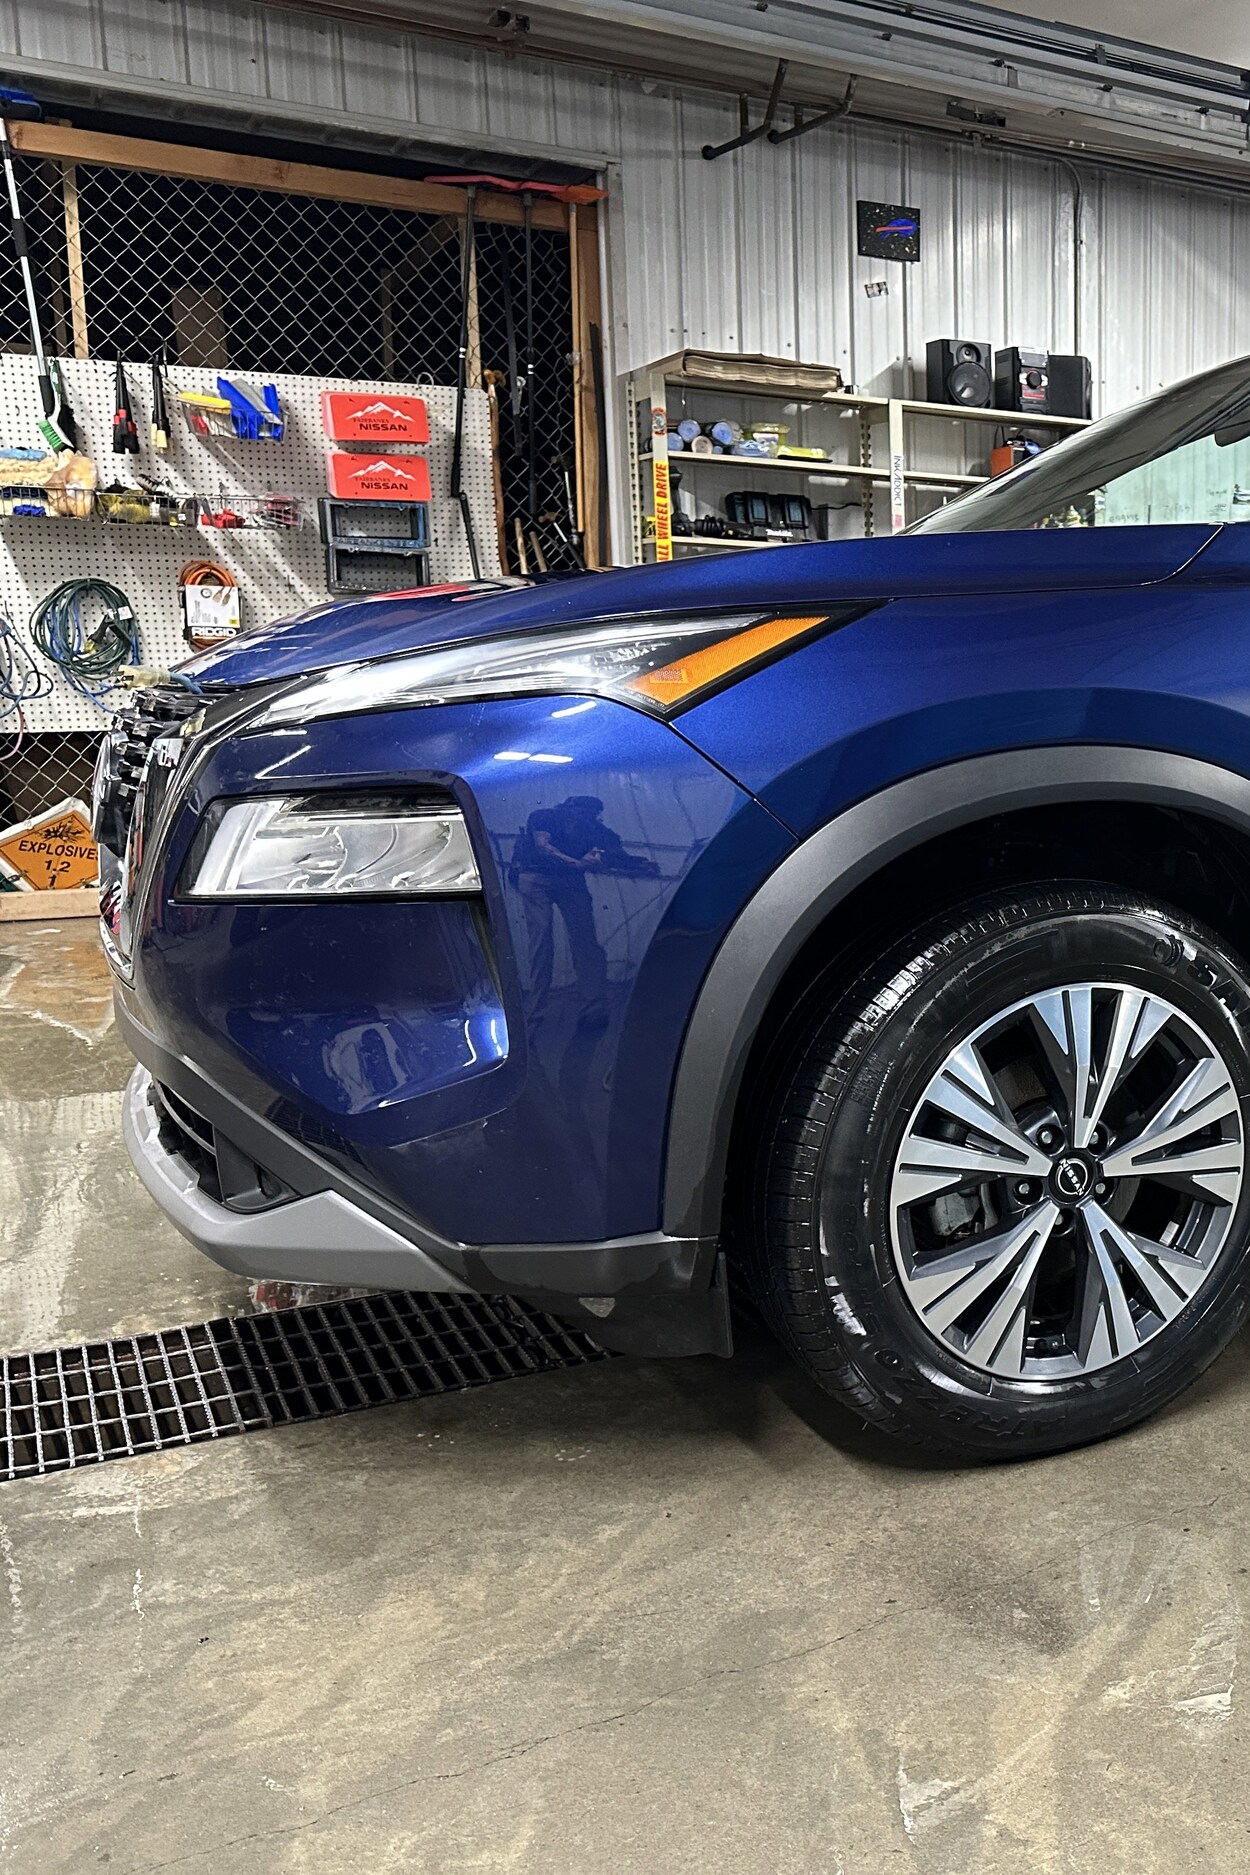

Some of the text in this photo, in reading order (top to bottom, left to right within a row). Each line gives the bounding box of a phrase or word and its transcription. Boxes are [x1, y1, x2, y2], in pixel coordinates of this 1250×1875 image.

[359, 423, 408, 432] NISSAN
[360, 482, 409, 490] NISSAN
[655, 462, 668, 499] DRIVE
[656, 502, 669, 540] WHEEL
[191, 627, 237, 637] RIDGID
[18, 839, 98, 861] EXPLOSIVE
[44, 859, 71, 873] 1.2
[47, 874, 57, 888] 1
[1059, 1158, 1084, 1196] NISSAN
